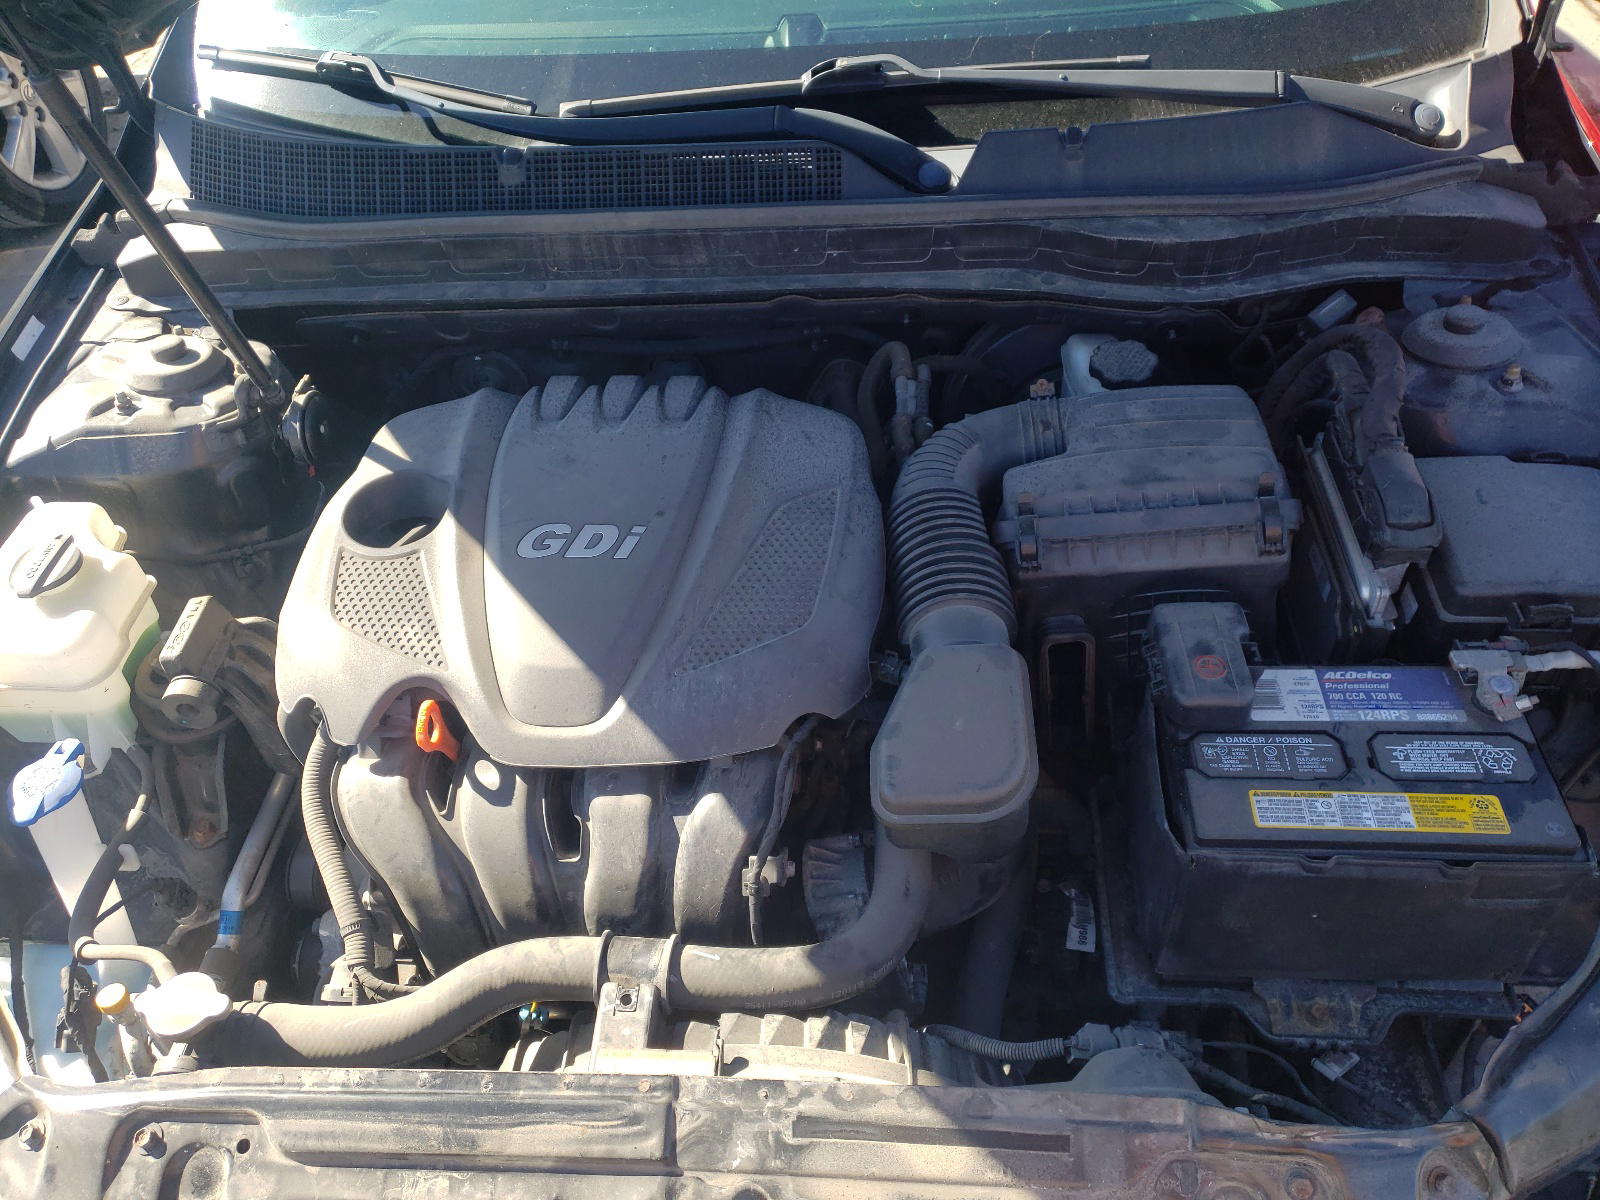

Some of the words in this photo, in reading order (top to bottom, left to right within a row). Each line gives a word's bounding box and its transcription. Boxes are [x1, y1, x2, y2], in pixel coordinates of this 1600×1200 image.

[516, 523, 648, 559] GDi
[1323, 671, 1392, 680] ACDelco
[1325, 682, 1389, 690] Professional
[1328, 692, 1344, 700] 700
[1346, 692, 1367, 700] CCA
[1371, 692, 1387, 700] 120
[1389, 692, 1403, 700] RC
[1358, 709, 1410, 721] 124RPS
[1225, 736, 1266, 744] DANGER
